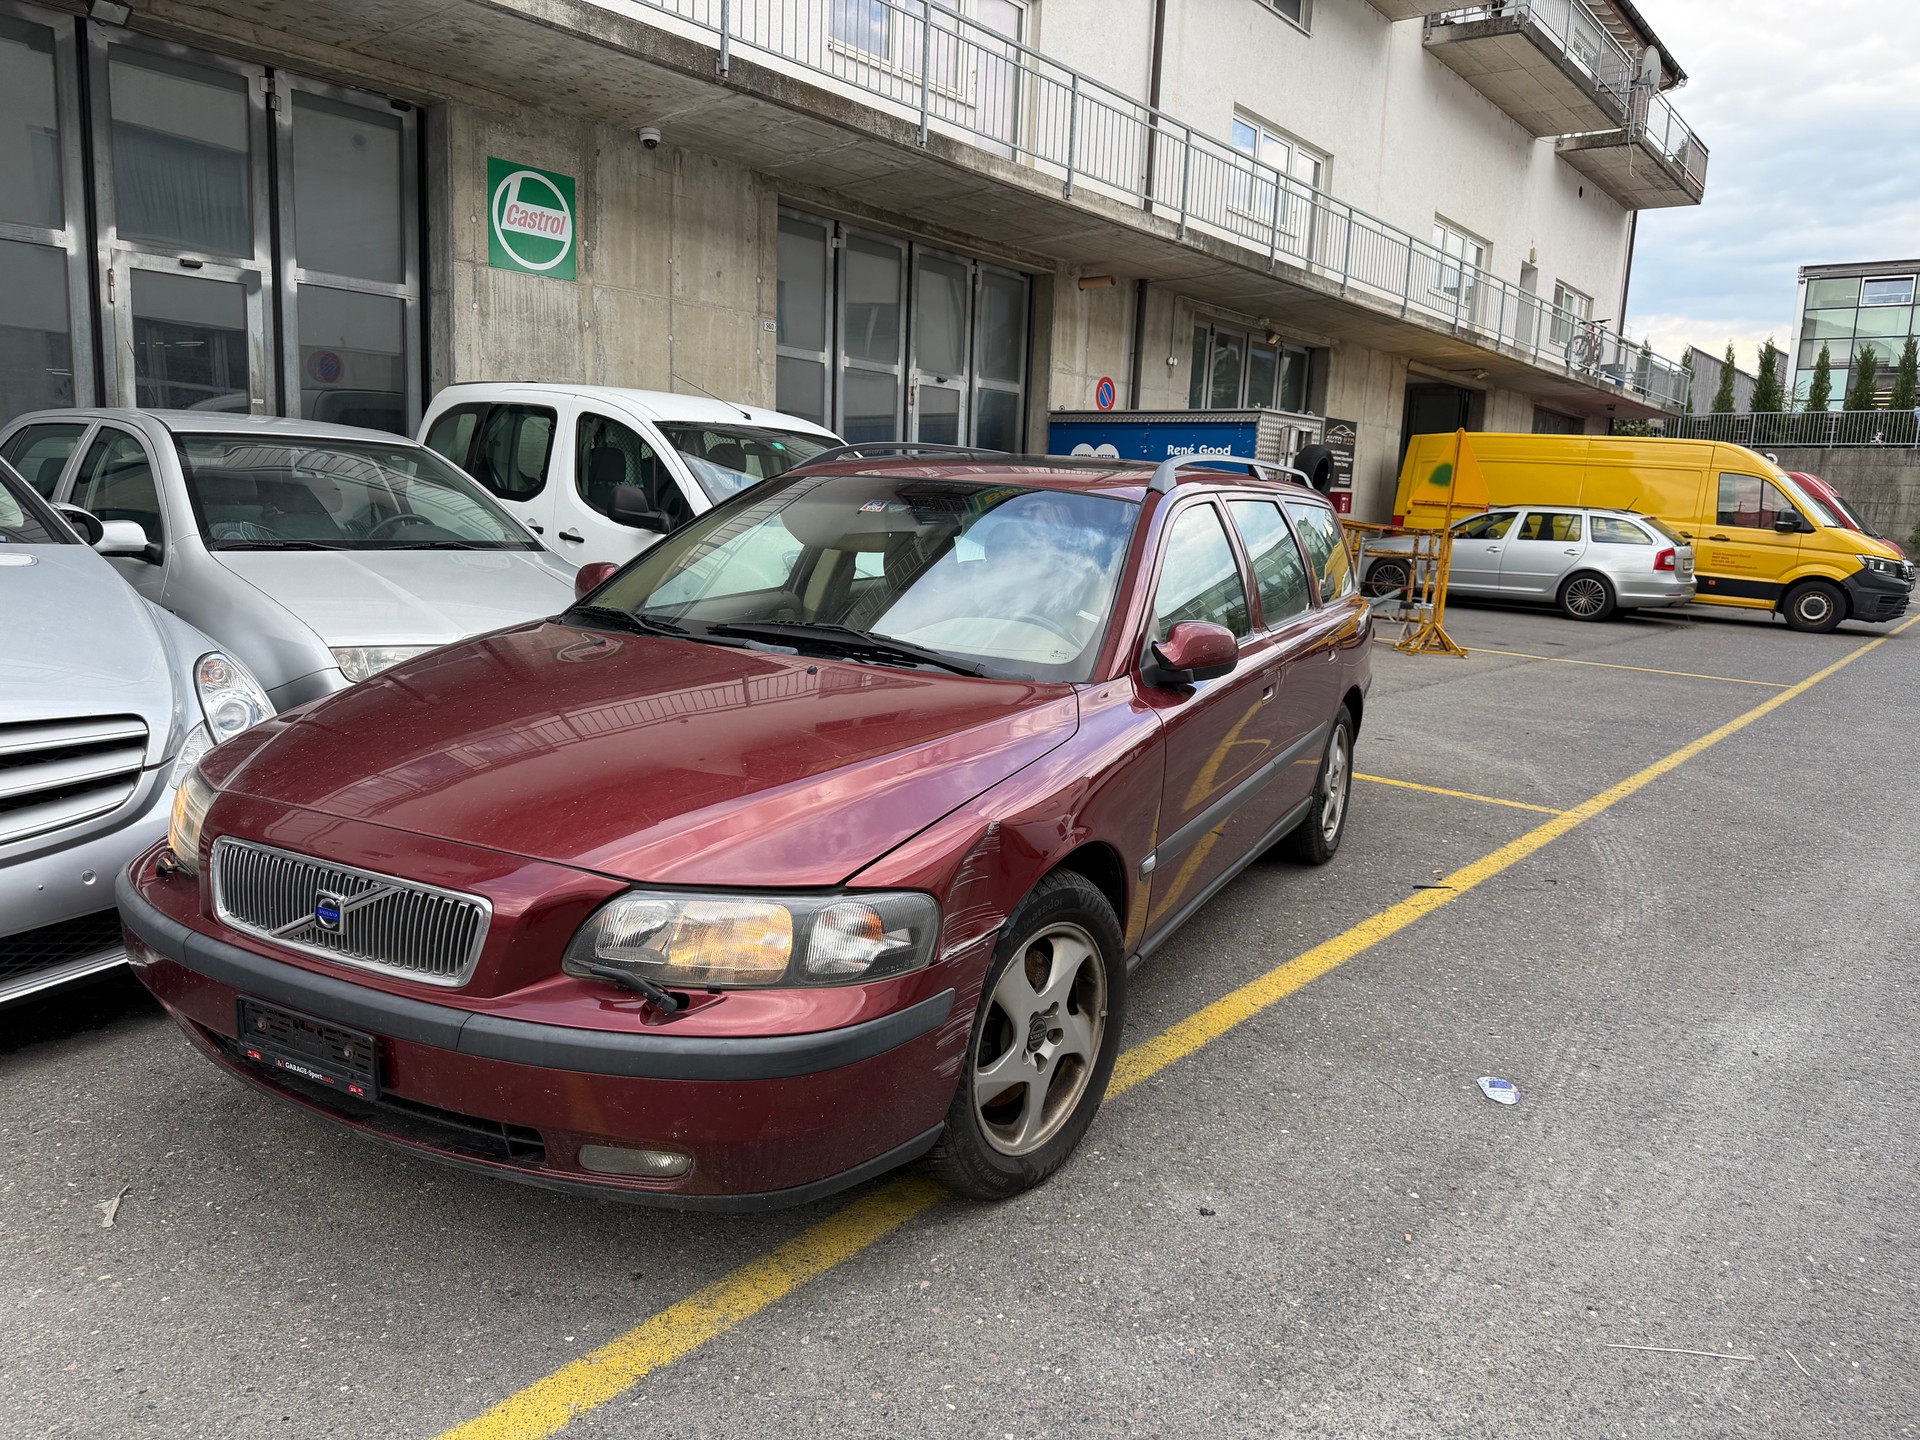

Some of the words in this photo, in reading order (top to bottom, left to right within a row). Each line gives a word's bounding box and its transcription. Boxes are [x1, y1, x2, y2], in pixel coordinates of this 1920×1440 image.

[506, 203, 567, 236] Castrol
[1325, 435, 1342, 444] AUTO
[1167, 443, 1195, 455] René
[1199, 444, 1231, 455] Good
[319, 909, 338, 918] VOLVO
